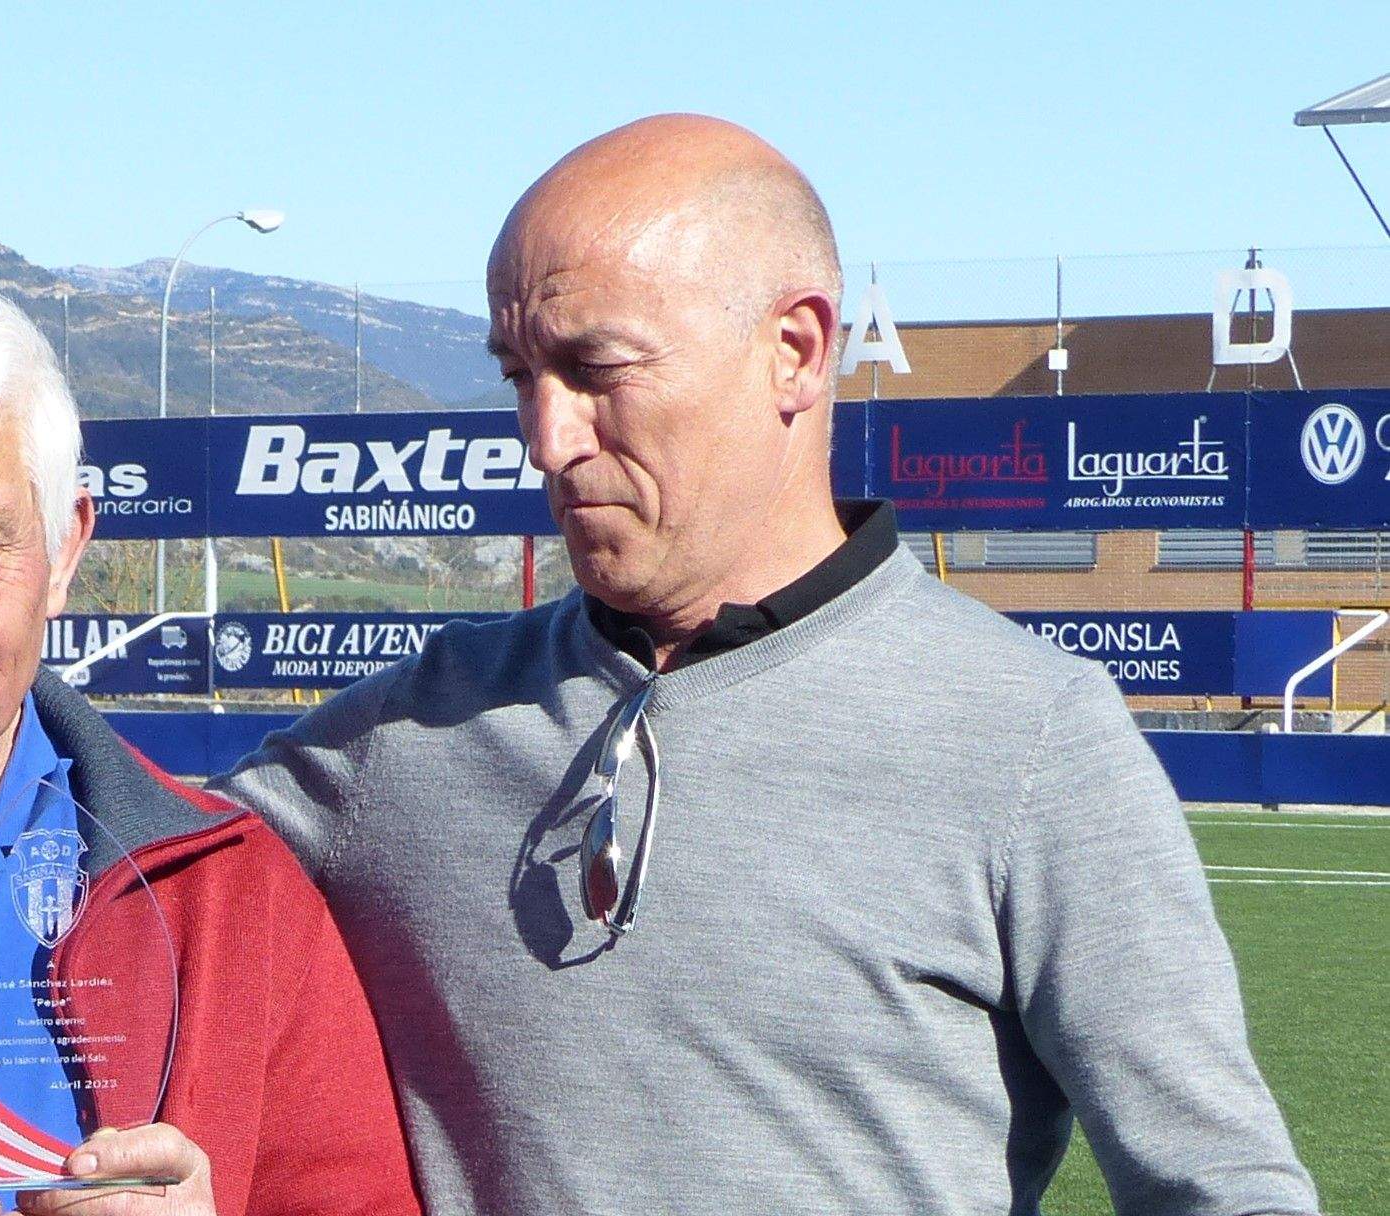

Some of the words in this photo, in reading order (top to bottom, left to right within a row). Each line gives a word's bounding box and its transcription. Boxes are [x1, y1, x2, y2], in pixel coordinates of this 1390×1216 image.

[1213, 267, 1294, 365] D
[891, 420, 1048, 500] Laguarta
[1067, 418, 1229, 497] Laguarta
[325, 499, 476, 531] SABIÑÁNIGO
[1063, 496, 1132, 508] ABOGADOS
[1134, 495, 1225, 507] ECONOMISTAS
[262, 624, 334, 655] BICI
[337, 624, 442, 655] AVEN
[272, 660, 318, 676] MODA
[322, 661, 332, 676] Y
